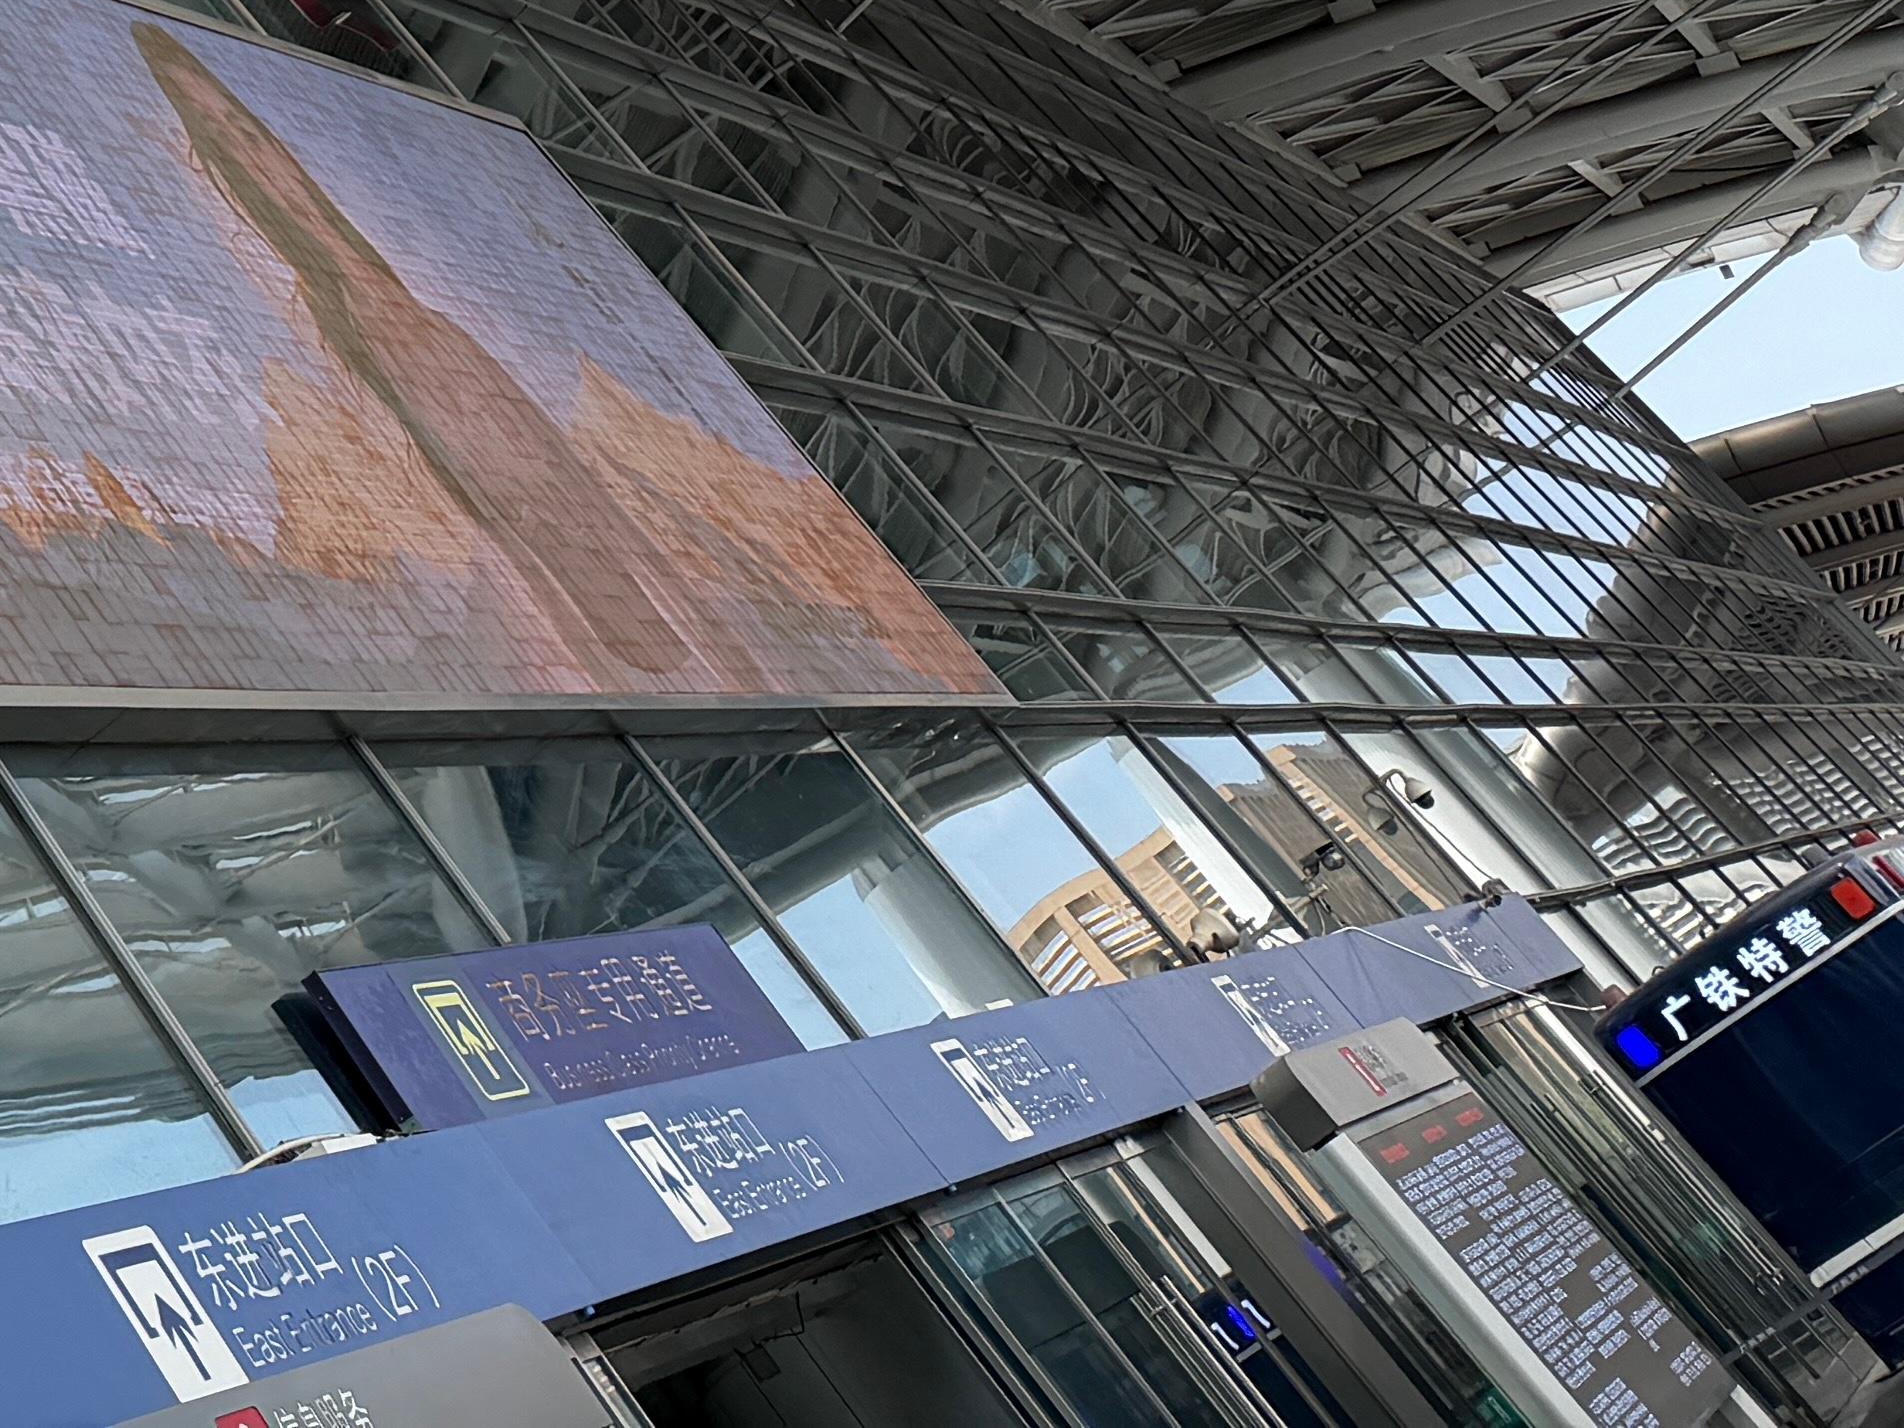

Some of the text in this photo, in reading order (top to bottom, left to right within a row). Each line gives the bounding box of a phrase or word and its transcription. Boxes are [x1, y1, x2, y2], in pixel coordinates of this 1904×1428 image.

[486, 950, 712, 1041] 商务座专用通道
[1660, 907, 1832, 1042] 广铁特警
[666, 1106, 775, 1177] 东进站口
[779, 1135, 844, 1191] (2F)
[179, 1212, 343, 1311] 东进站口
[352, 1243, 440, 1322] (2F)
[232, 1303, 378, 1367] East Entrance
